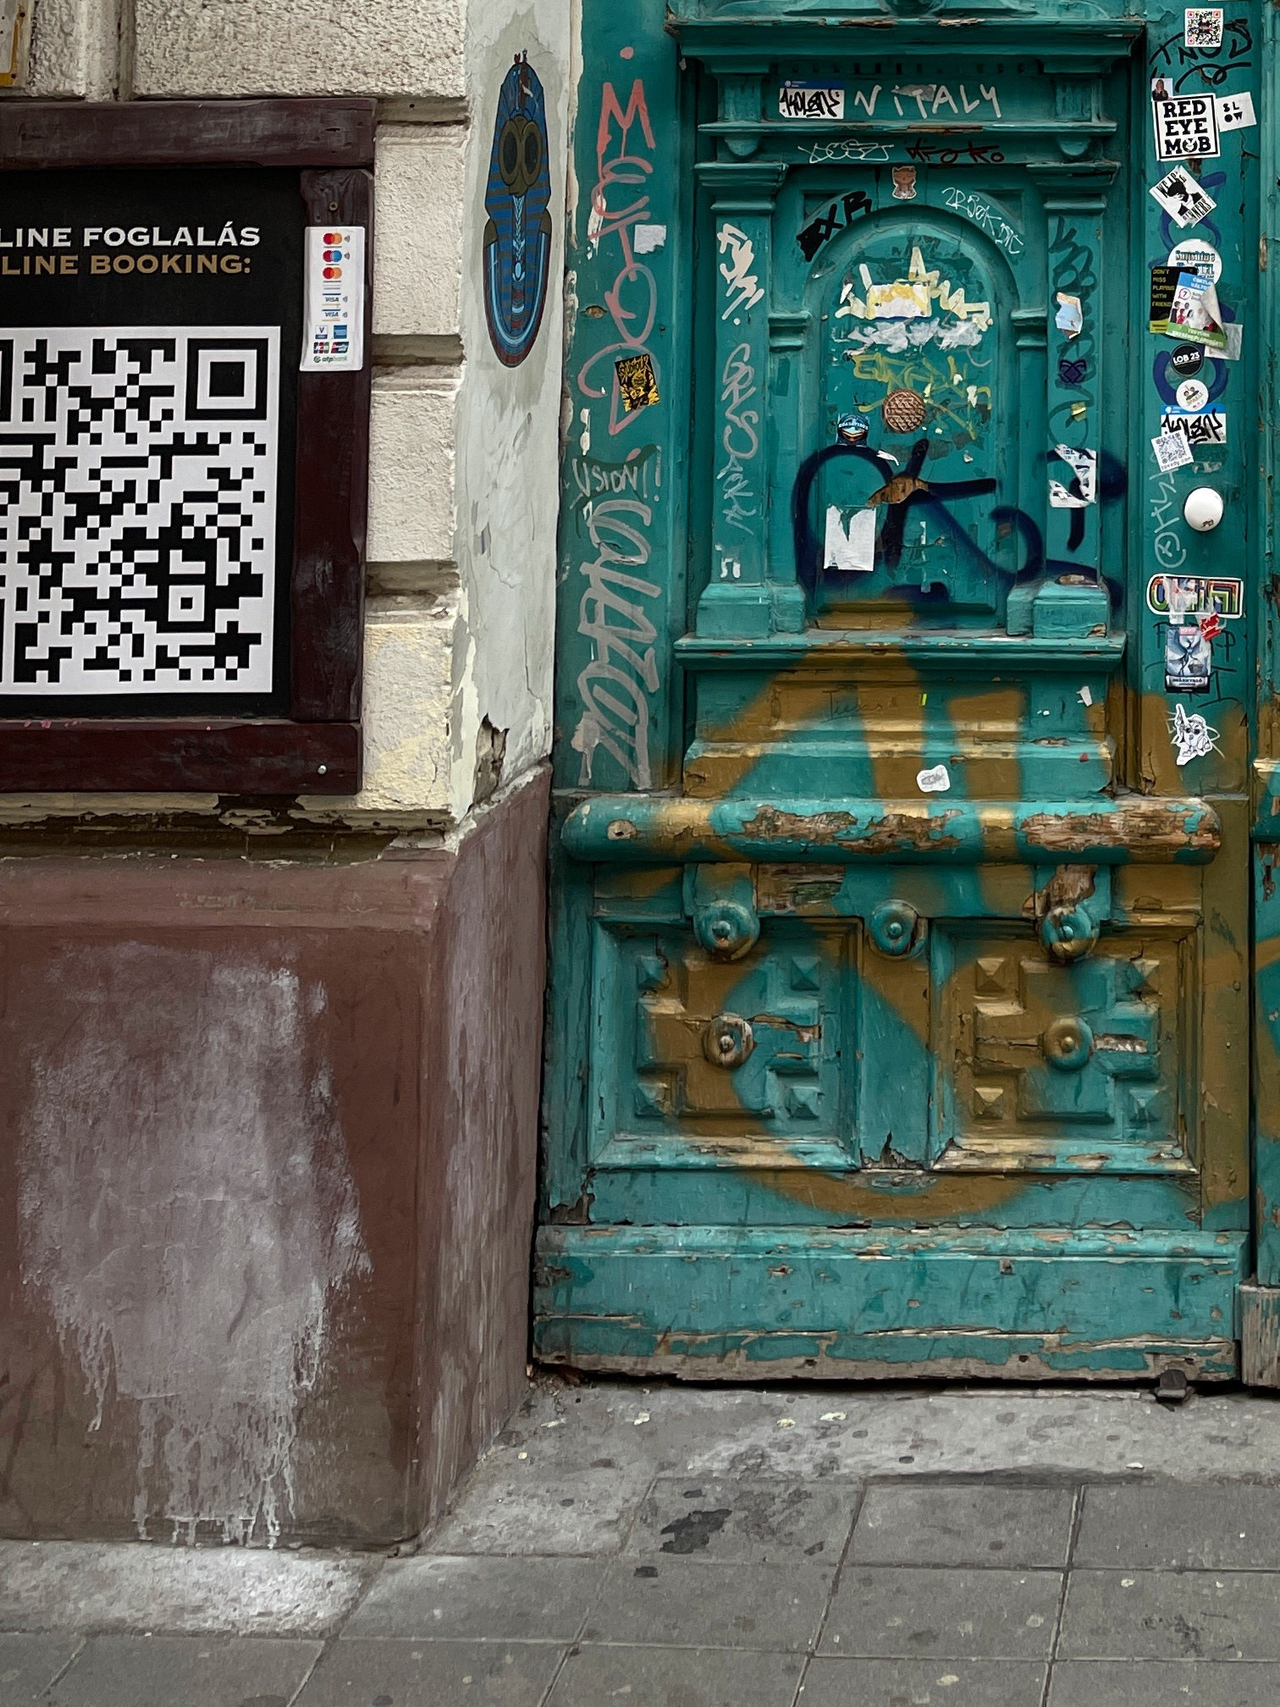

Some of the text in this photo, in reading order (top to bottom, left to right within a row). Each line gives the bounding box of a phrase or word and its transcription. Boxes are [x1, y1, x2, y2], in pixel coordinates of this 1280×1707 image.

[1163, 100, 1206, 119] RED
[1164, 118, 1208, 137] EYE
[1164, 137, 1212, 155] MOB
[83, 221, 260, 247] FOGLALÁS
[2, 254, 251, 275] LINE BOOKING:
[1172, 351, 1201, 364] LOB 23
